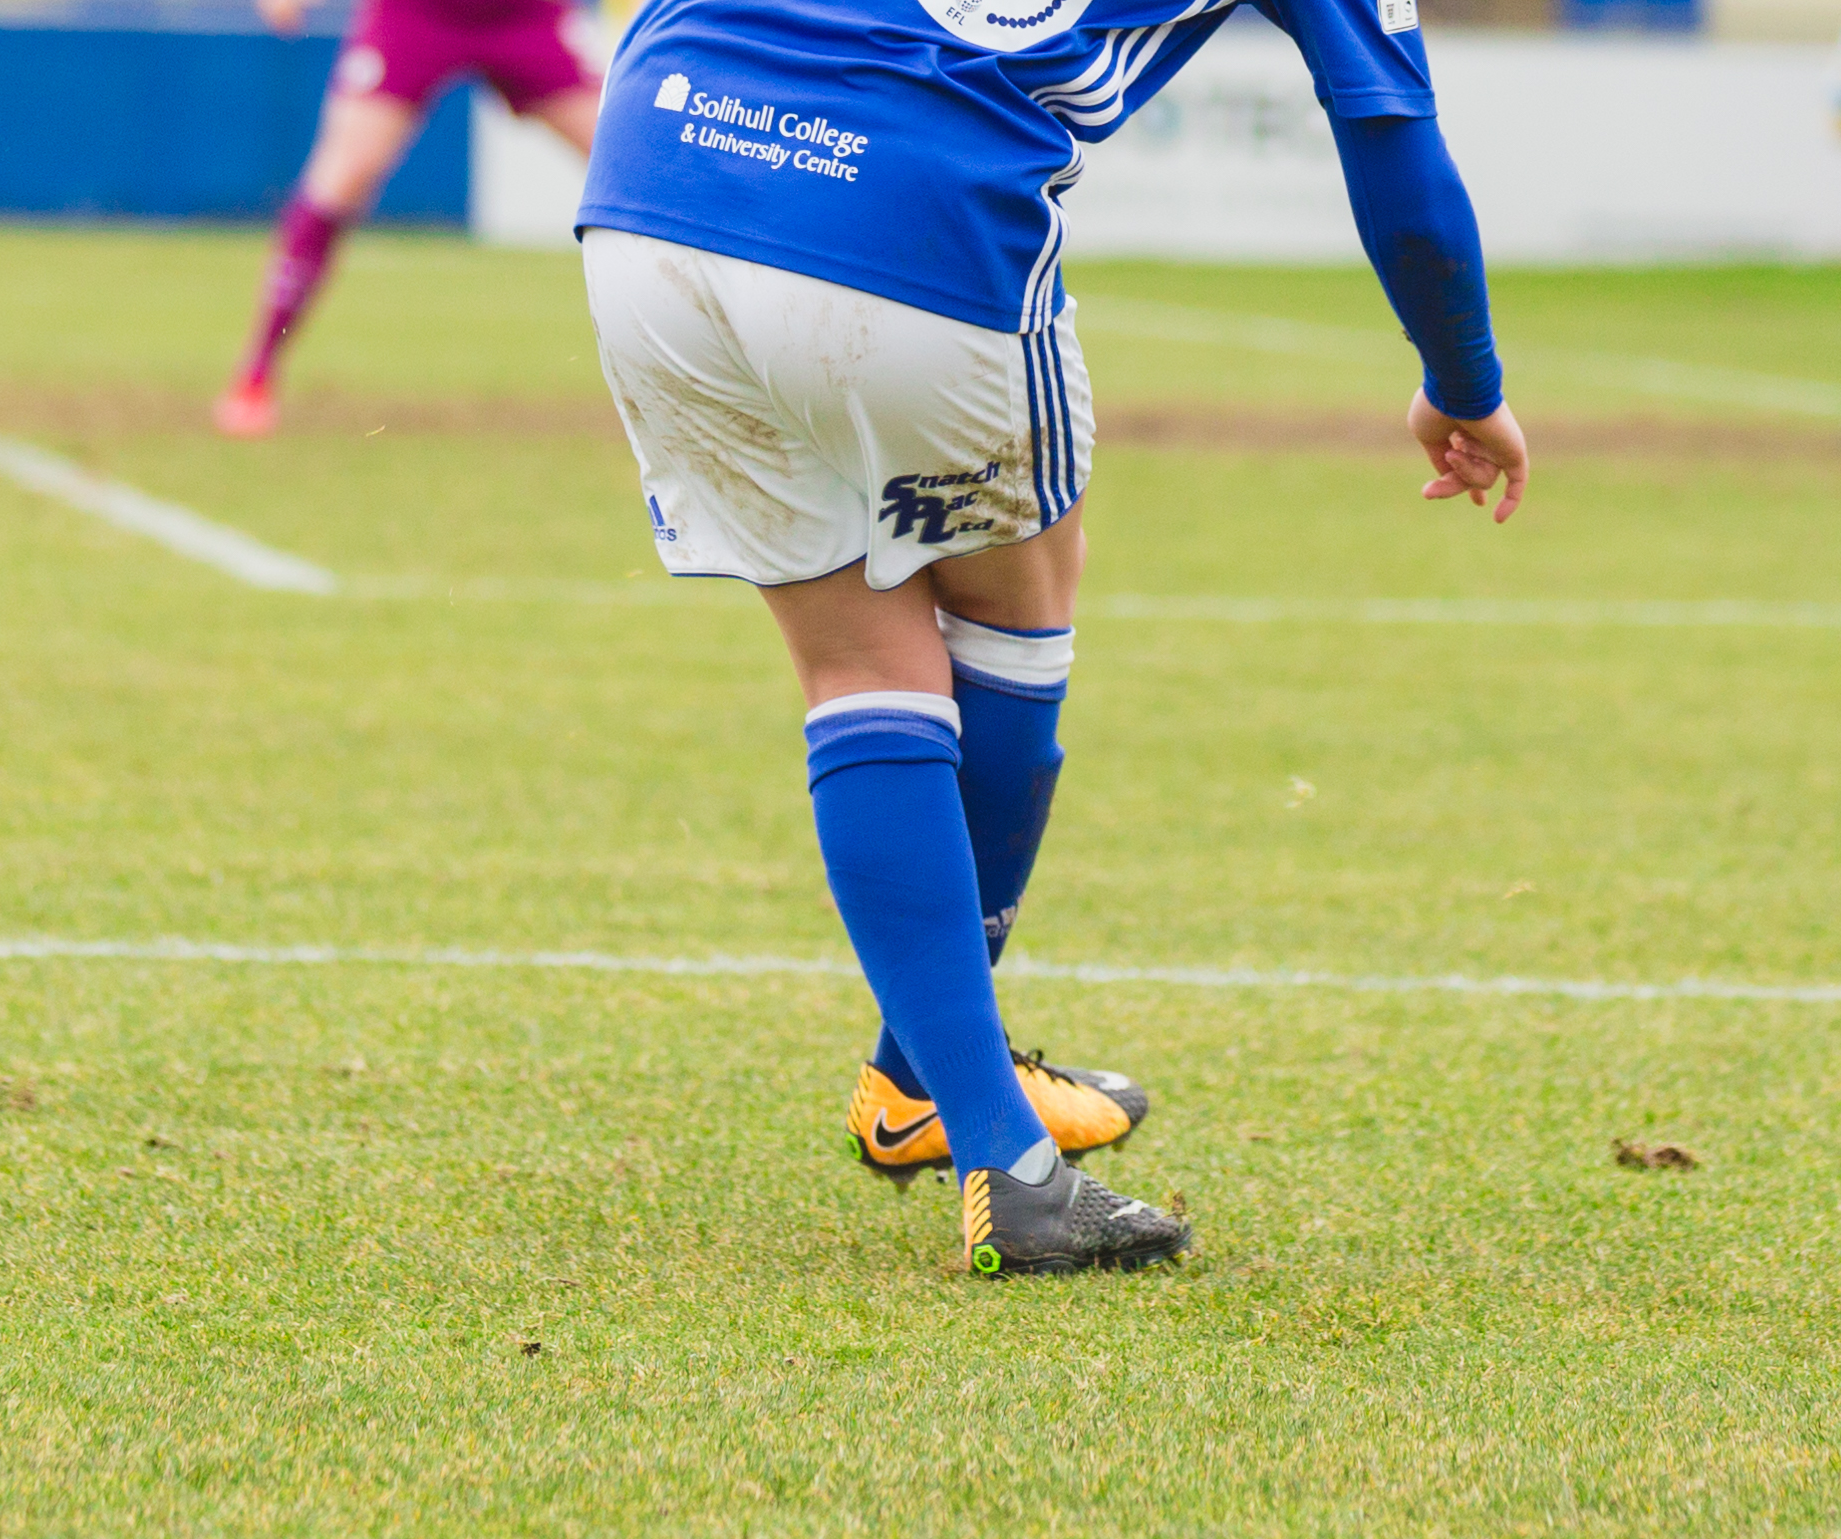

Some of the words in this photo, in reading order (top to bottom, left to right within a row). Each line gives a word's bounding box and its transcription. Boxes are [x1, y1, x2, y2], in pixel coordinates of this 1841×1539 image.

[945, 6, 966, 26] EFL
[680, 123, 696, 144] &
[698, 126, 791, 170] University
[793, 149, 859, 182] Centre
[689, 92, 775, 132] Solihull
[778, 113, 869, 158] College
[878, 460, 1002, 524] Snatch
[917, 509, 995, 544] Ltd
